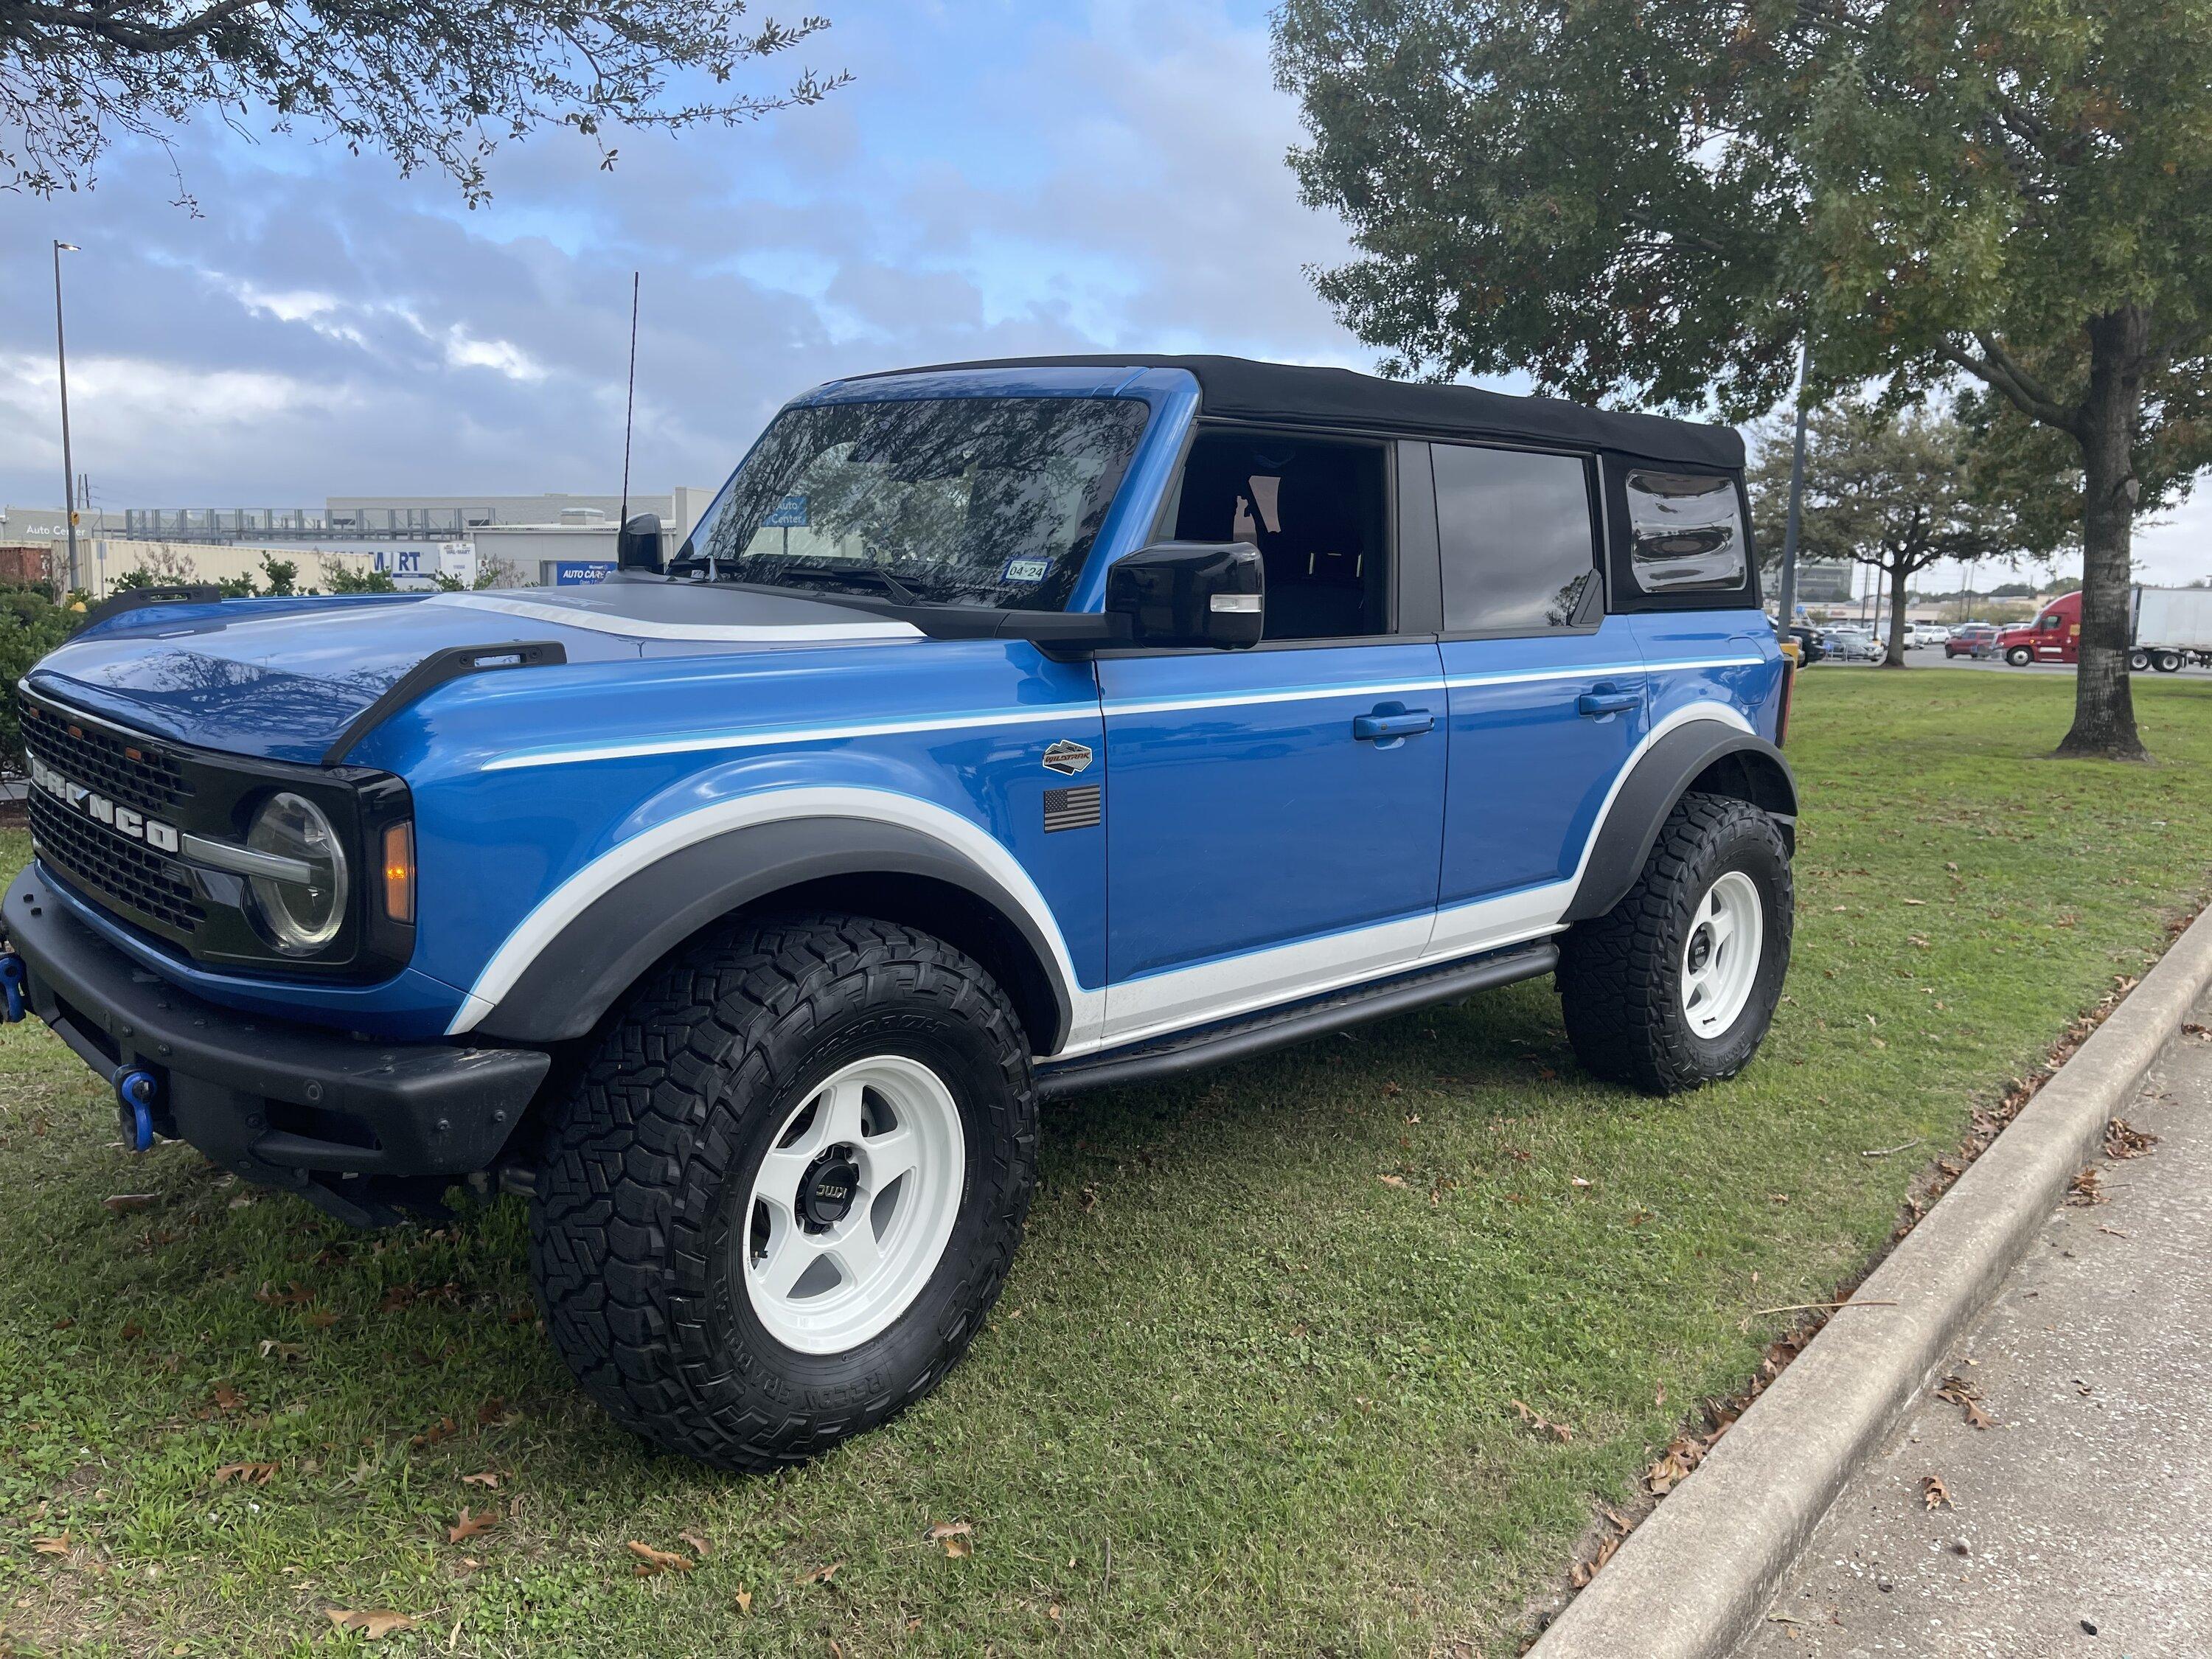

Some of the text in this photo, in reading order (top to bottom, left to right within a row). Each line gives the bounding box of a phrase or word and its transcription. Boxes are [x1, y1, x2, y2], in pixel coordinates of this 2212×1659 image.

[771, 514, 802, 524] Center
[27, 525, 86, 536] Auto Ceer
[563, 570, 583, 579] AUTO
[584, 571, 605, 579] CARE
[1009, 566, 1043, 577] 04 24
[1045, 752, 1090, 764] WILDTRAK
